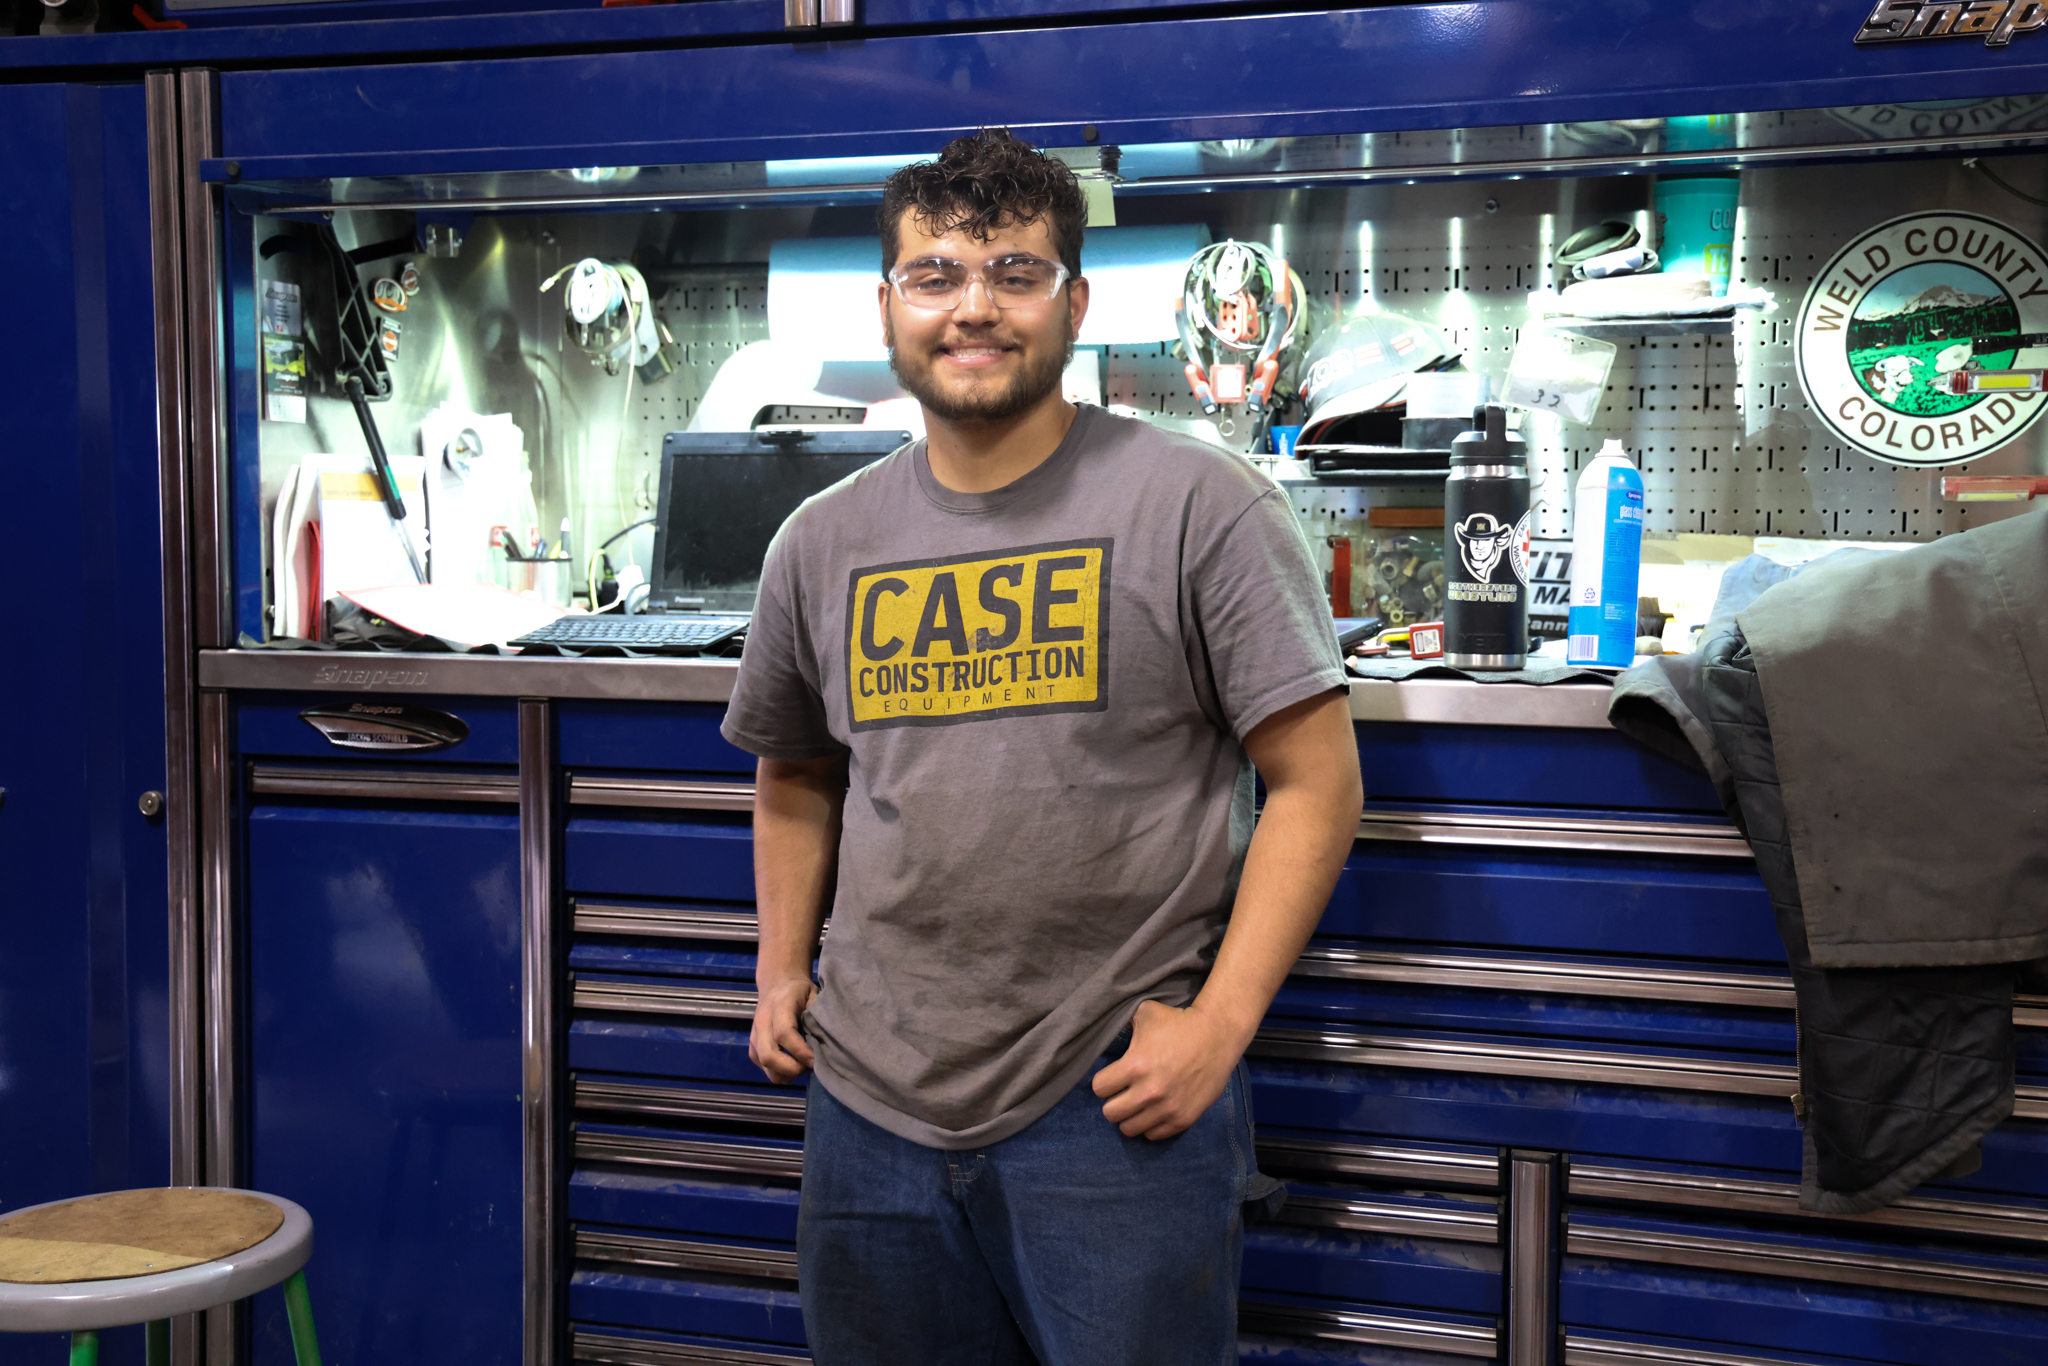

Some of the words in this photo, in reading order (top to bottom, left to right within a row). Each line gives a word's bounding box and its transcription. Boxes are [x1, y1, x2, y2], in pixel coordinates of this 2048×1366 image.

[1813, 244, 1891, 331] WELD
[1905, 226, 2048, 301] COUNTY
[860, 556, 1087, 662] CASE
[1448, 590, 1517, 602] WRESTLING
[313, 663, 428, 690] Snap-on
[859, 646, 1085, 698] CONSTRUCTION
[349, 703, 403, 715] Snap-on
[884, 684, 1056, 713] EQUIPMENT
